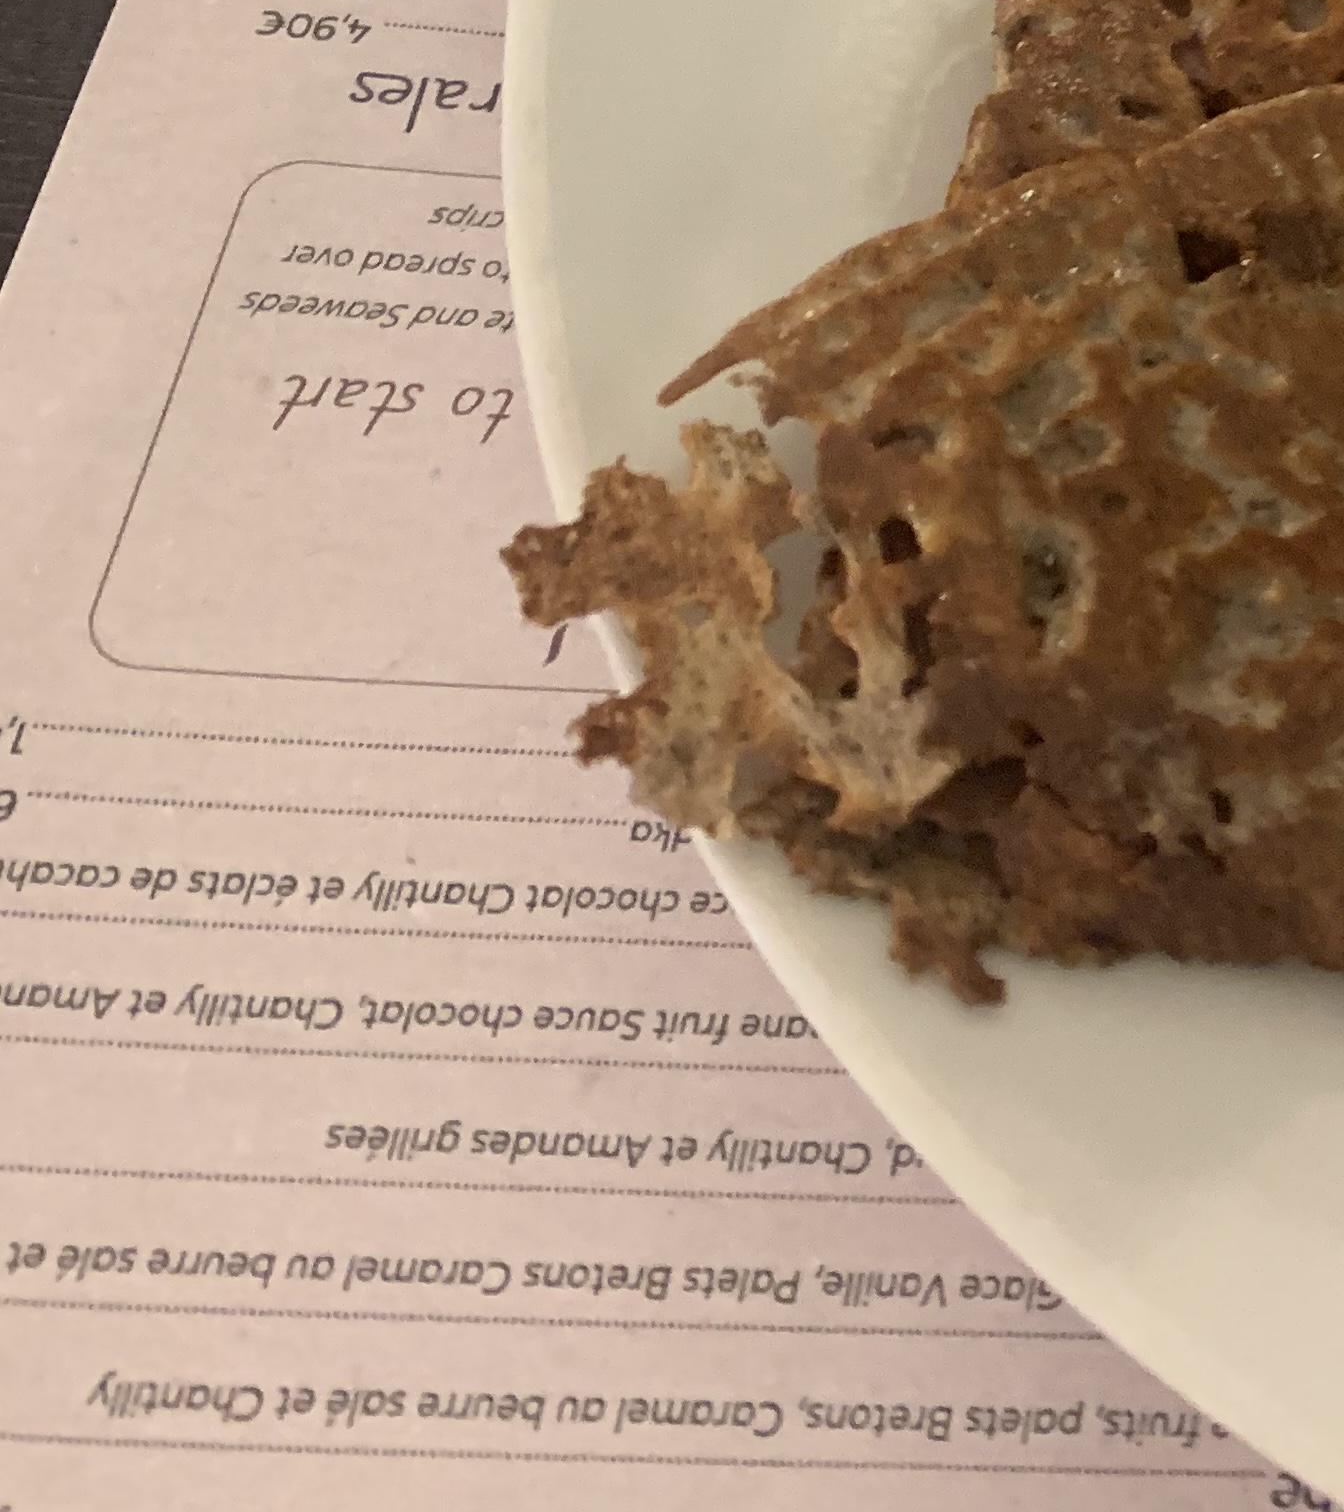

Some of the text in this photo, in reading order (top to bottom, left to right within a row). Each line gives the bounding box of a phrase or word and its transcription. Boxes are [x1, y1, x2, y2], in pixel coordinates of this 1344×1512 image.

[254, 9, 373, 45] 4,90€
[347, 71, 503, 135] rales
[426, 203, 506, 233] crips
[278, 244, 355, 268] over
[357, 251, 477, 278] spread
[236, 290, 410, 329] Seaweeds
[405, 305, 480, 331] and
[272, 374, 515, 445] to start
[0, 859, 121, 894] cacah
[129, 866, 178, 901] de
[188, 868, 298, 906] éclats
[303, 875, 346, 905] et
[351, 870, 516, 915] Chantilly
[524, 883, 681, 921] chocolat
[0, 982, 121, 1021] Aman
[126, 988, 168, 1022] et
[174, 983, 344, 1032] Chantilly
[358, 994, 524, 1040] chocolat,
[532, 1005, 646, 1042] Sauce
[651, 1009, 731, 1045] fruit
[323, 1120, 462, 1162] grillées
[471, 1128, 652, 1169] Amandes
[659, 1136, 698, 1164] et
[705, 1129, 872, 1176] Chantilly
[5, 1240, 47, 1277] et
[55, 1241, 138, 1282] salé
[145, 1246, 277, 1289] beurre
[286, 1251, 336, 1284] au
[341, 1253, 512, 1297] Caramel
[523, 1259, 673, 1303] Bretons
[681, 1264, 802, 1306] Palets
[812, 1262, 948, 1308] Vanille,
[86, 1370, 265, 1424] Chantilly
[274, 1385, 316, 1420] et
[324, 1386, 407, 1429] salé
[416, 1391, 545, 1430] beurre
[556, 1395, 607, 1423] au
[613, 1395, 783, 1439] Caramel
[796, 1395, 953, 1442] Bretons,
[963, 1400, 1085, 1443] palets
[1095, 1404, 1202, 1449] fruits,
